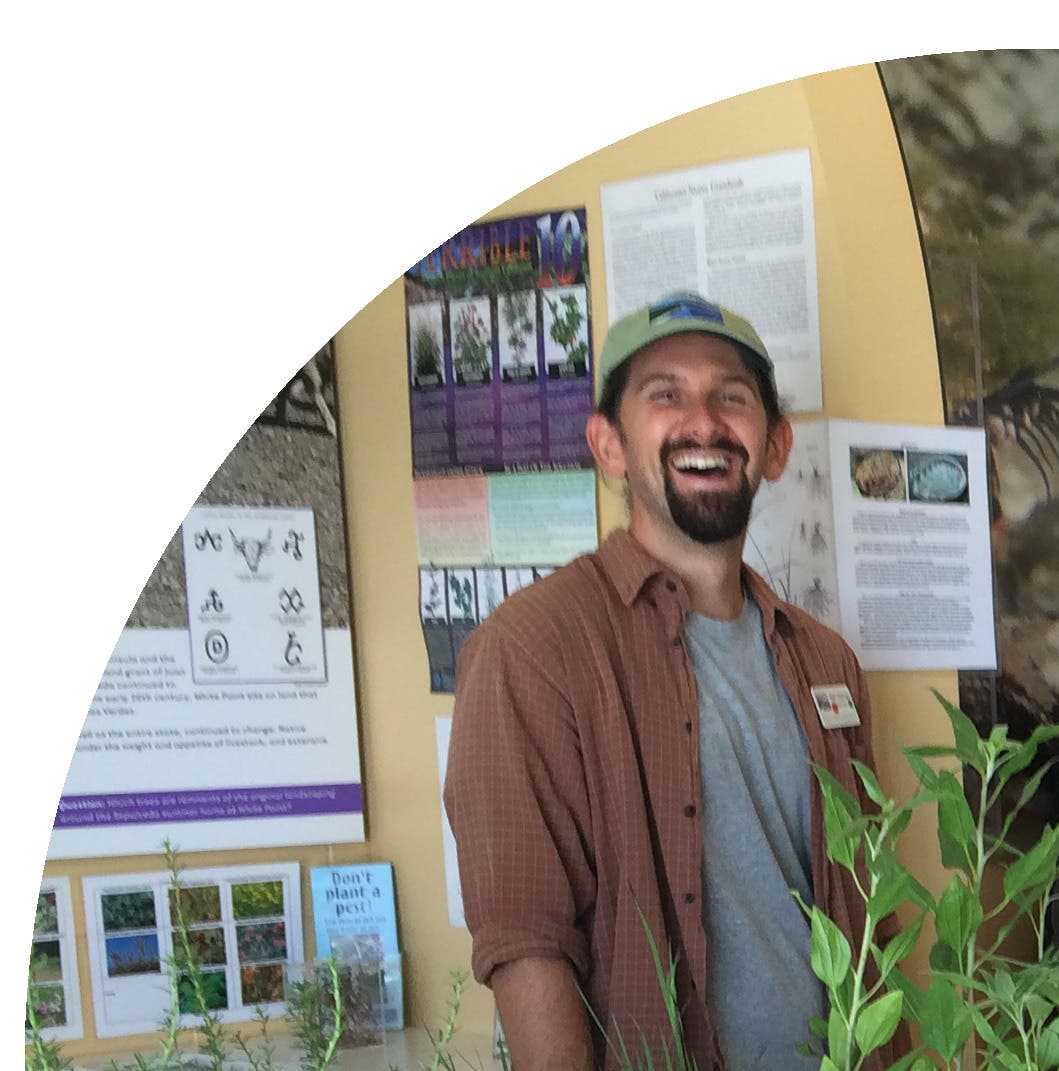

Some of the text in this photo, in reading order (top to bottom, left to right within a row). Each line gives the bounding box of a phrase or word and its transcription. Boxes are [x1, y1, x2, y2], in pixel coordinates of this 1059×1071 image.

[535, 210, 582, 288] 10
[332, 872, 372, 886] Don't
[326, 887, 381, 903] plant a
